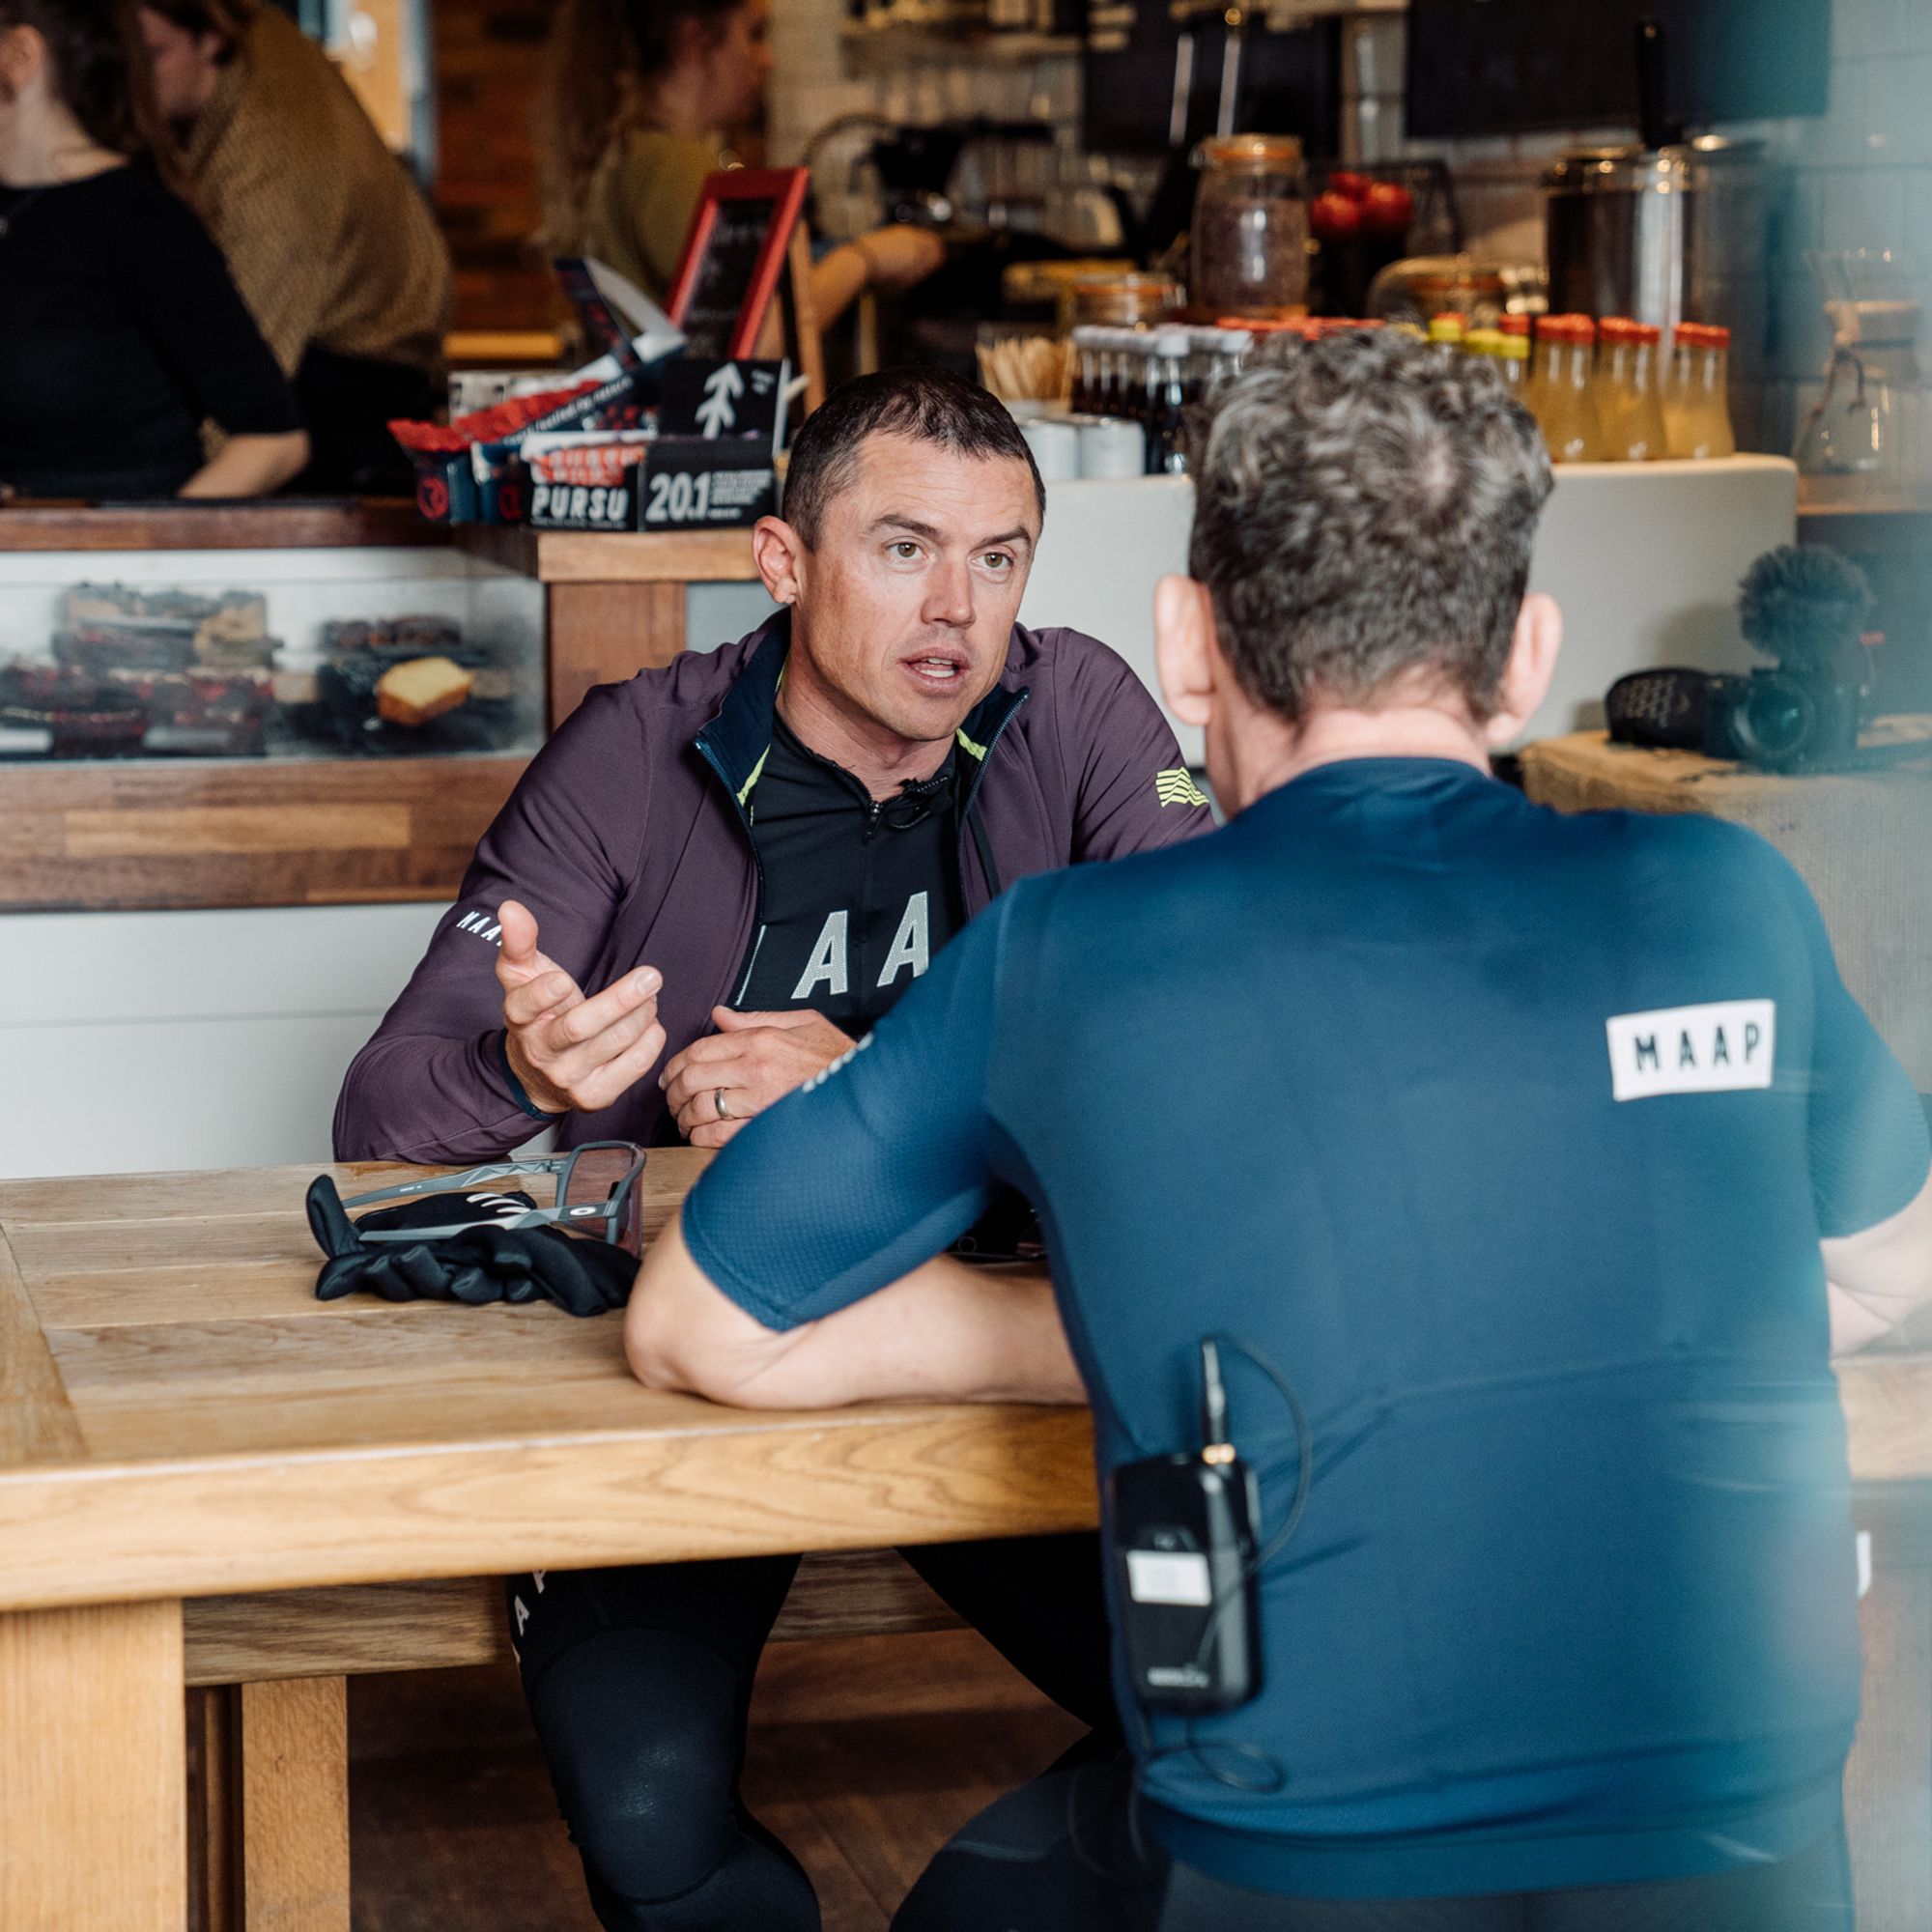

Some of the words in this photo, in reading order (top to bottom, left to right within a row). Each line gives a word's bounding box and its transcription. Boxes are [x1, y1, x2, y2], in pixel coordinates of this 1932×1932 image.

[530, 485, 629, 521] PURSU
[645, 470, 712, 522] 20.1
[456, 911, 502, 947] MAA
[1634, 1023, 1759, 1071] MAAP
